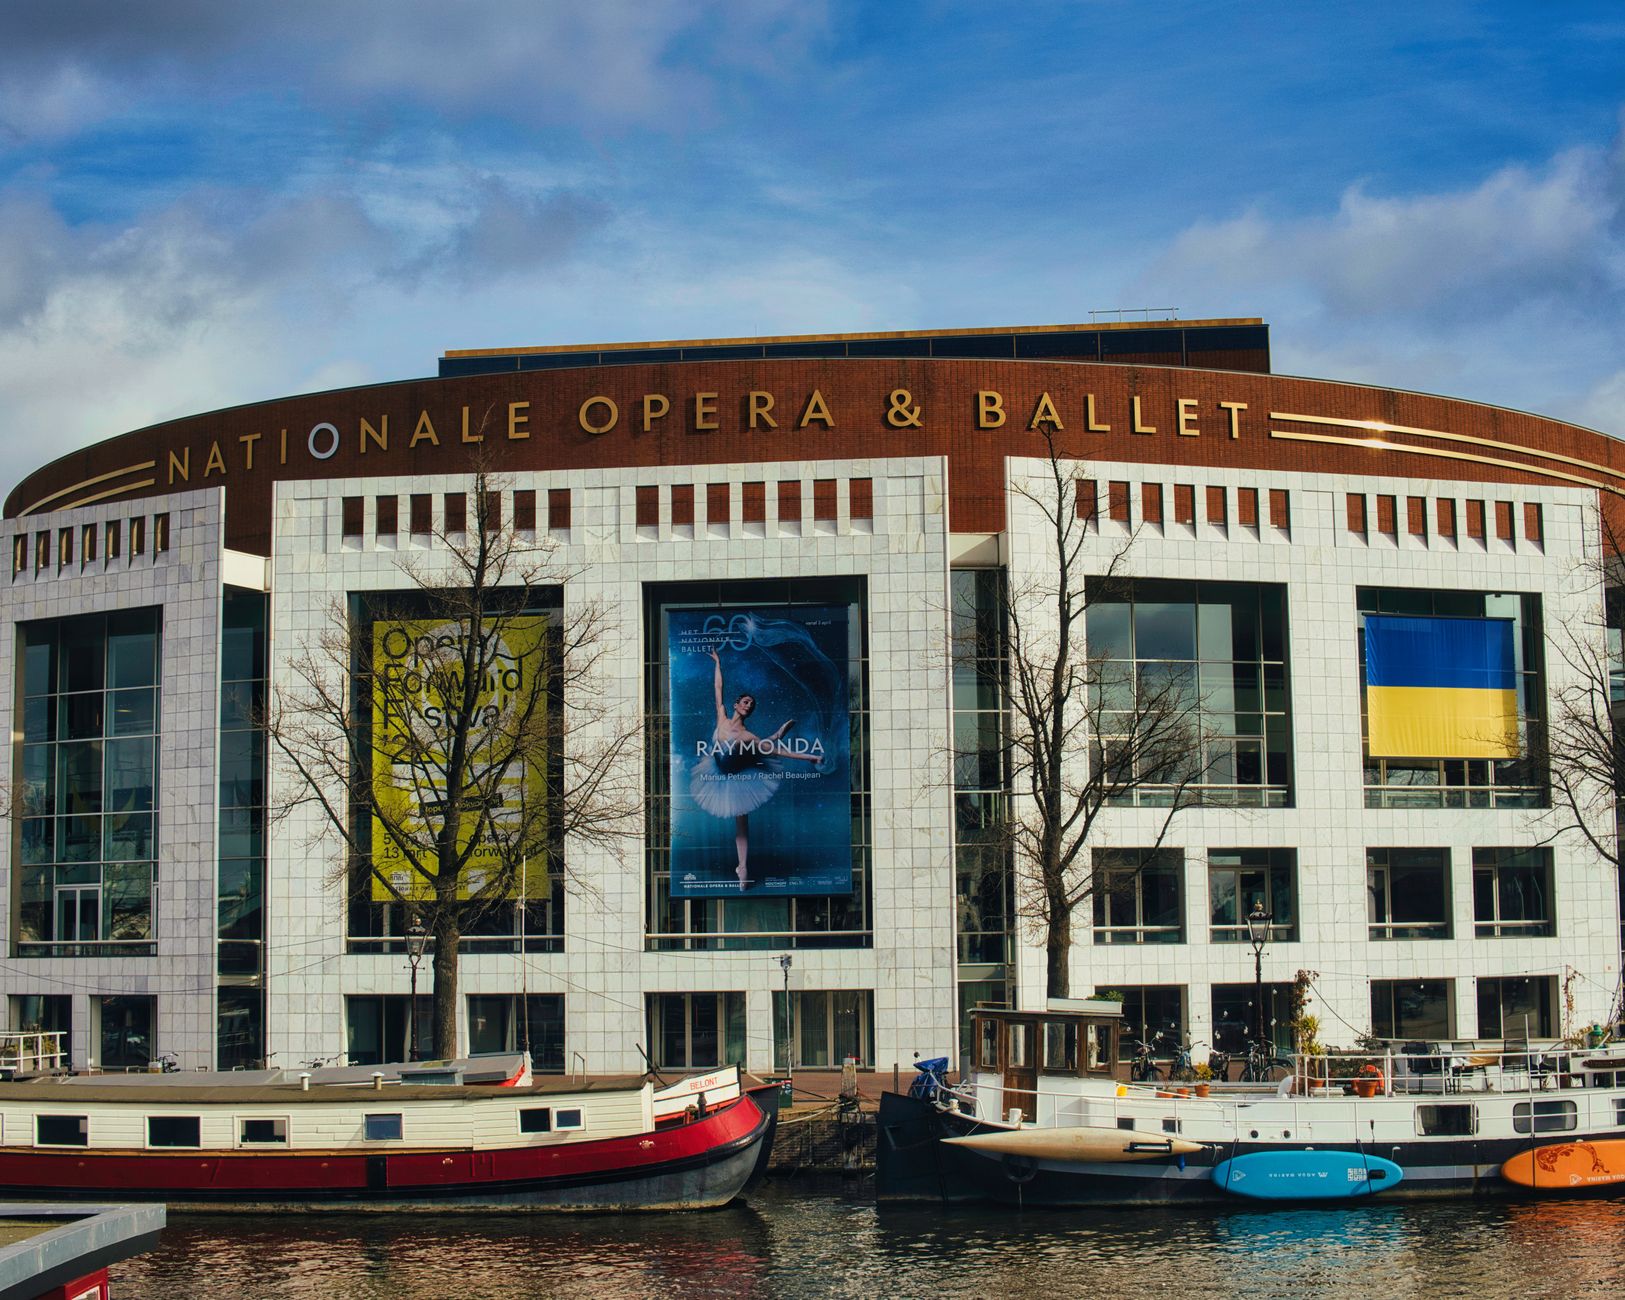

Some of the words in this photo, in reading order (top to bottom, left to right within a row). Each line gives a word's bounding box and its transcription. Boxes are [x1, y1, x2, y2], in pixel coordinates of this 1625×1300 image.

[168, 401, 530, 485] NATIONALE
[579, 390, 836, 434] OPERA
[887, 389, 922, 427] &
[978, 390, 1248, 439] BALLET
[382, 627, 487, 667] Oper
[681, 645, 711, 653] BALLET
[696, 738, 825, 757] RAYMONDA
[700, 773, 726, 781] Marius
[728, 773, 751, 782] Petipa
[758, 772, 784, 780] Rachel
[786, 771, 821, 781] Beaujean
[383, 847, 399, 859] 13
[690, 1077, 718, 1090] BELONT
